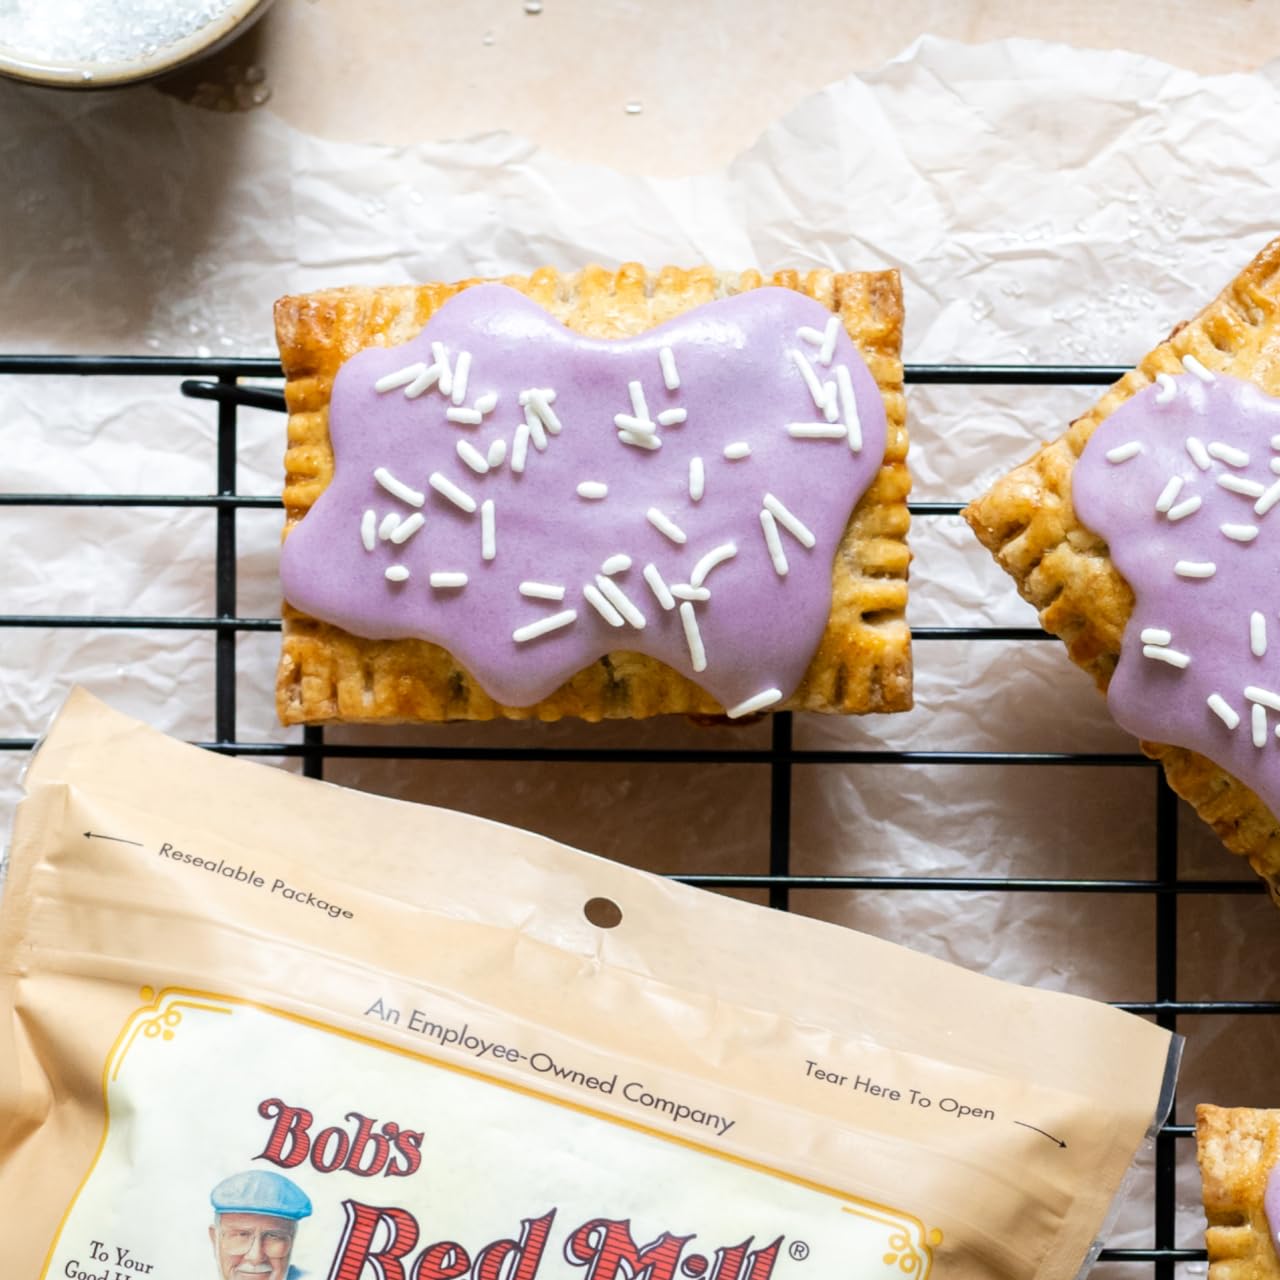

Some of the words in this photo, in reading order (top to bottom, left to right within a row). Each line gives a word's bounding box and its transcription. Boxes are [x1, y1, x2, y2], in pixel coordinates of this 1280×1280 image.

[159, 842, 265, 888] Resealable
[270, 879, 355, 920] Package
[364, 997, 400, 1024] An
[407, 1009, 617, 1094] Employee-Owned
[622, 1082, 736, 1136] Company
[805, 1060, 848, 1086] Tear
[853, 1075, 901, 1101] Here
[909, 1089, 931, 1108] To
[938, 1098, 995, 1121] Open
[90, 1240, 109, 1262] To
[114, 1247, 154, 1274] Your
